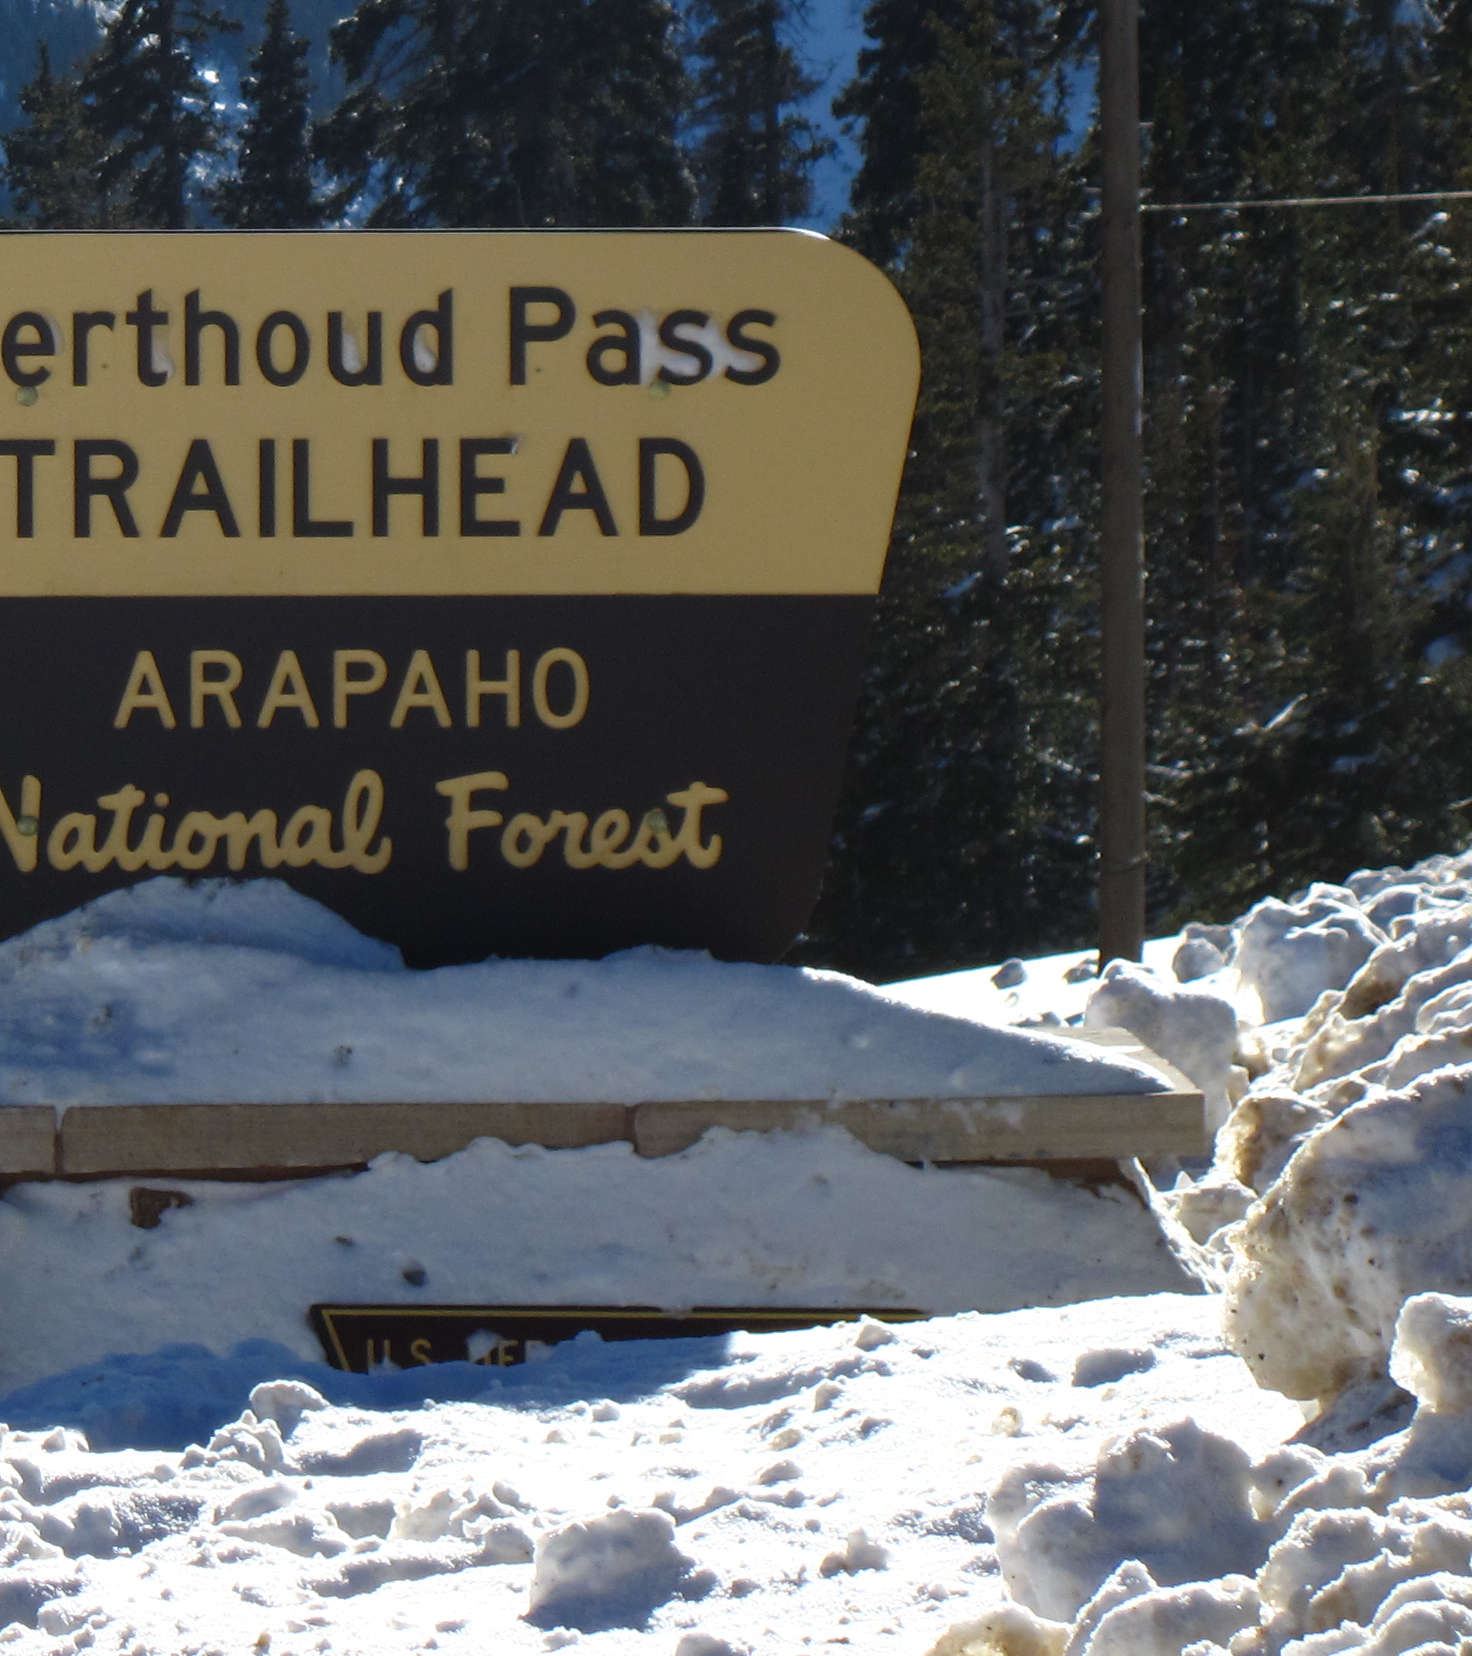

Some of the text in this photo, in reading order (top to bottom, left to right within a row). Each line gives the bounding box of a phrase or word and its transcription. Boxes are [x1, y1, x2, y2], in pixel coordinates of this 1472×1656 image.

[509, 286, 781, 386] Pass
[114, 648, 590, 730] ARAPAHO
[436, 771, 728, 871] Forest
